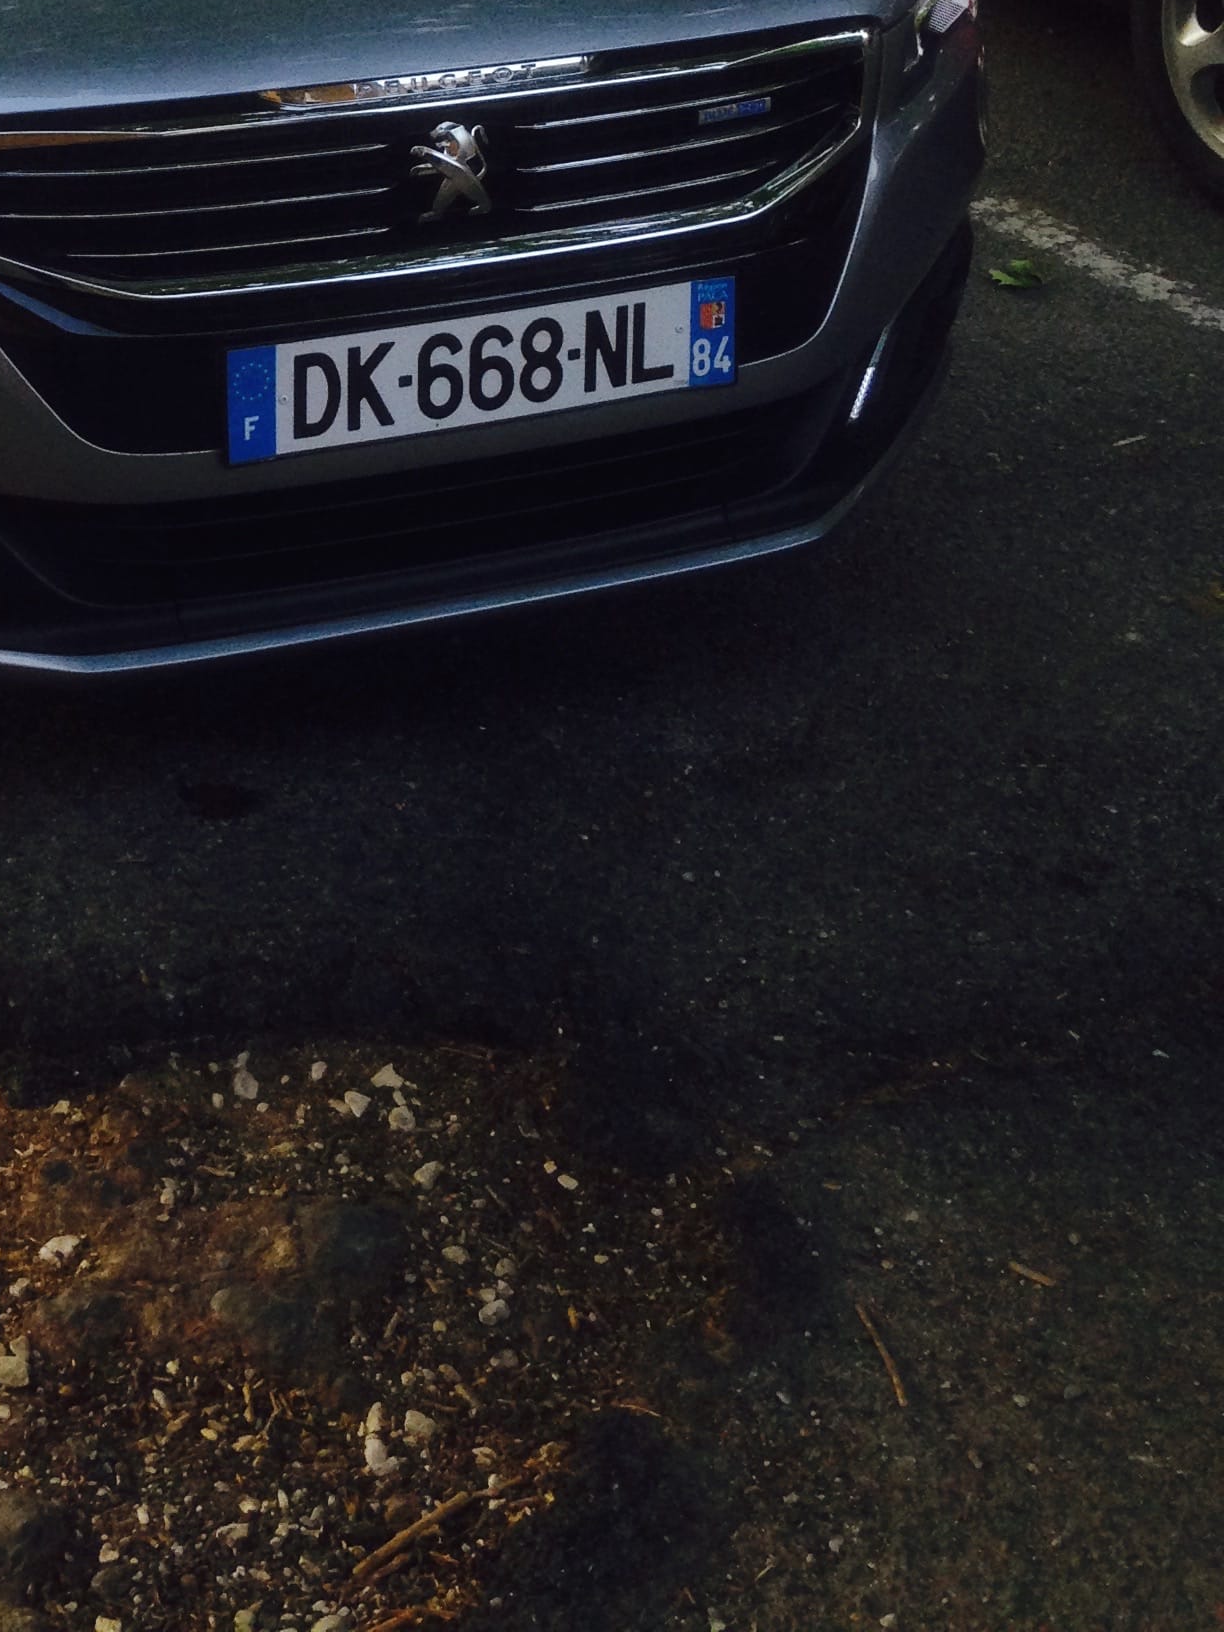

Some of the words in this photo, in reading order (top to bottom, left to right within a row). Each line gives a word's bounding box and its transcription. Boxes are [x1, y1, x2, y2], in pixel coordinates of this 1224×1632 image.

[293, 302, 674, 440] DK-668-NL
[692, 335, 732, 377] 84
[243, 415, 259, 441] F
